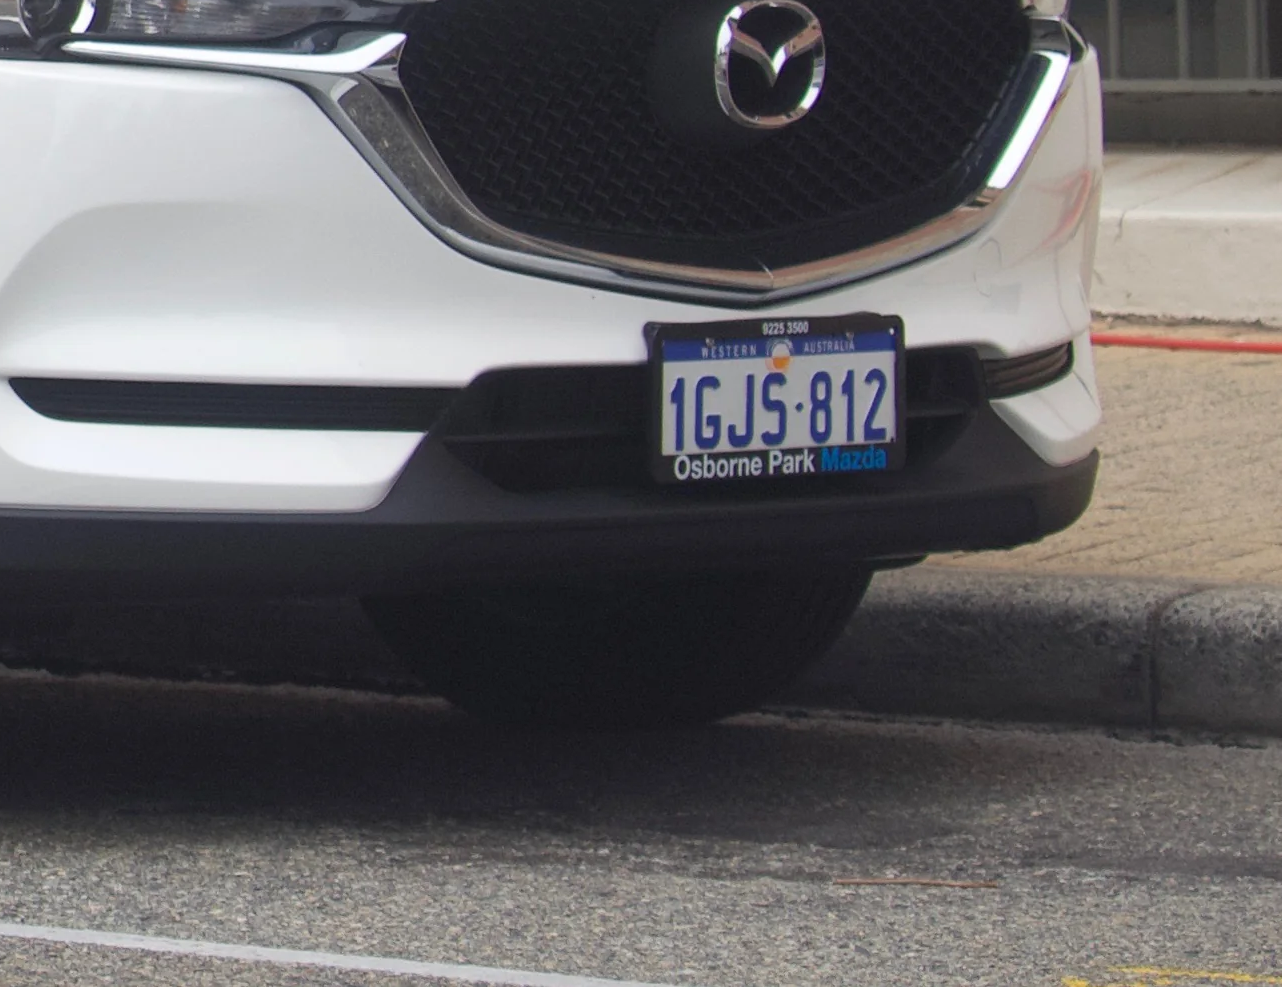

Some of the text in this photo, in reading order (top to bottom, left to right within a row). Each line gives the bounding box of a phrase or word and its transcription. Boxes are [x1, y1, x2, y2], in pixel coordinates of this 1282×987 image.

[762, 320, 809, 335] 9225 3500
[701, 338, 855, 359] WESTERN AUSTRALIA
[673, 444, 887, 481] Osborne Park Mazda
